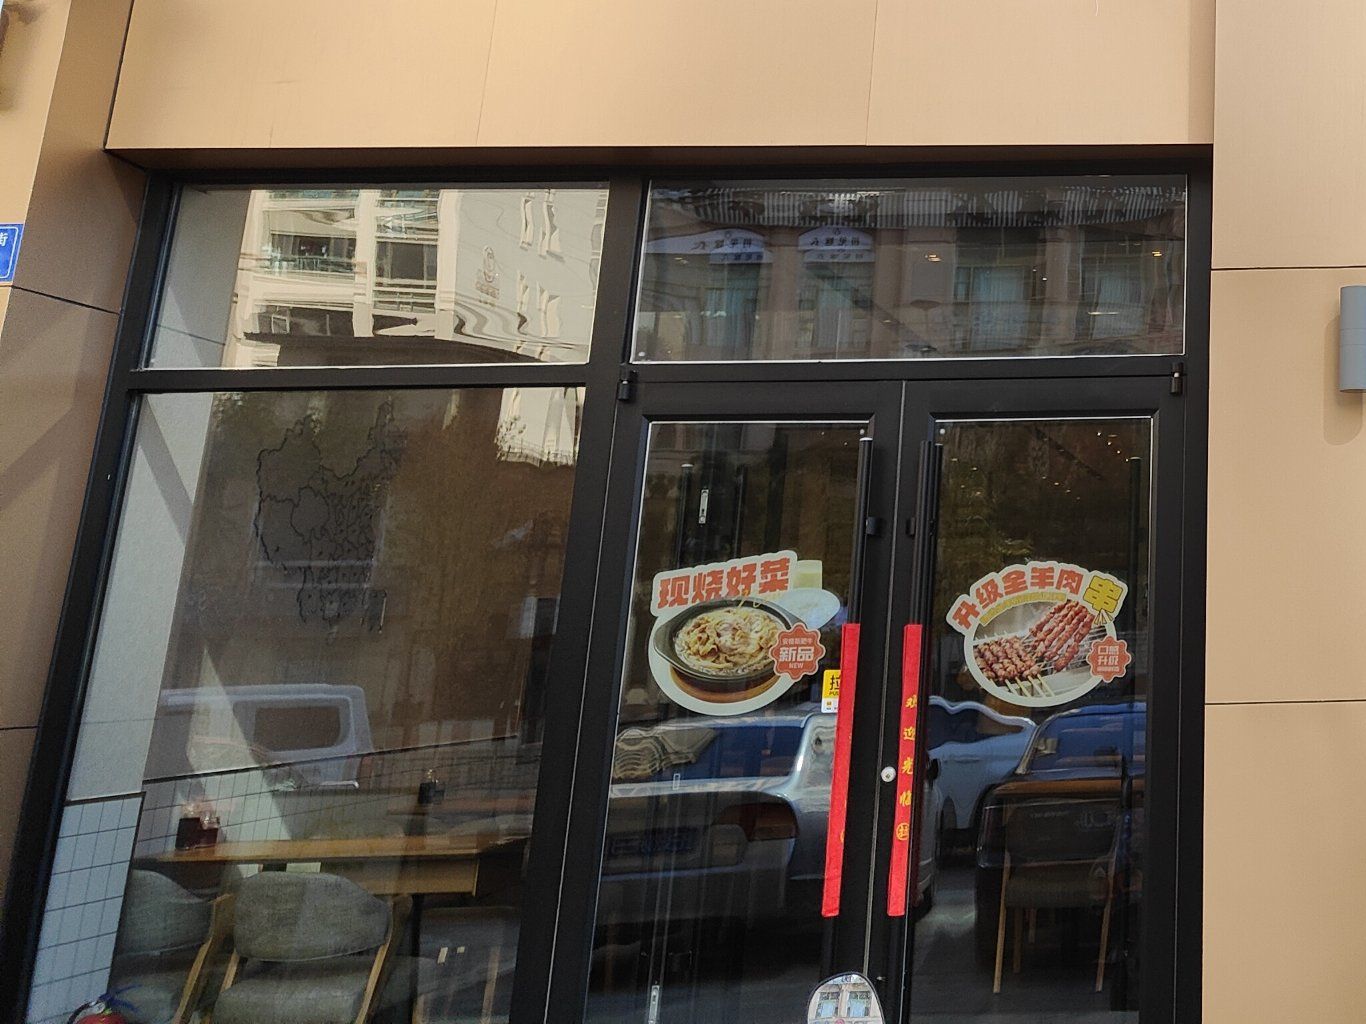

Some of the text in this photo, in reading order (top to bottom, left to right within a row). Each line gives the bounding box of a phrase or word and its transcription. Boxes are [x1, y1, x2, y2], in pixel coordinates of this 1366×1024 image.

[657, 557, 791, 609] 现烧好菜
[778, 646, 815, 662] 新品
[899, 693, 919, 809] 欢迎光临
